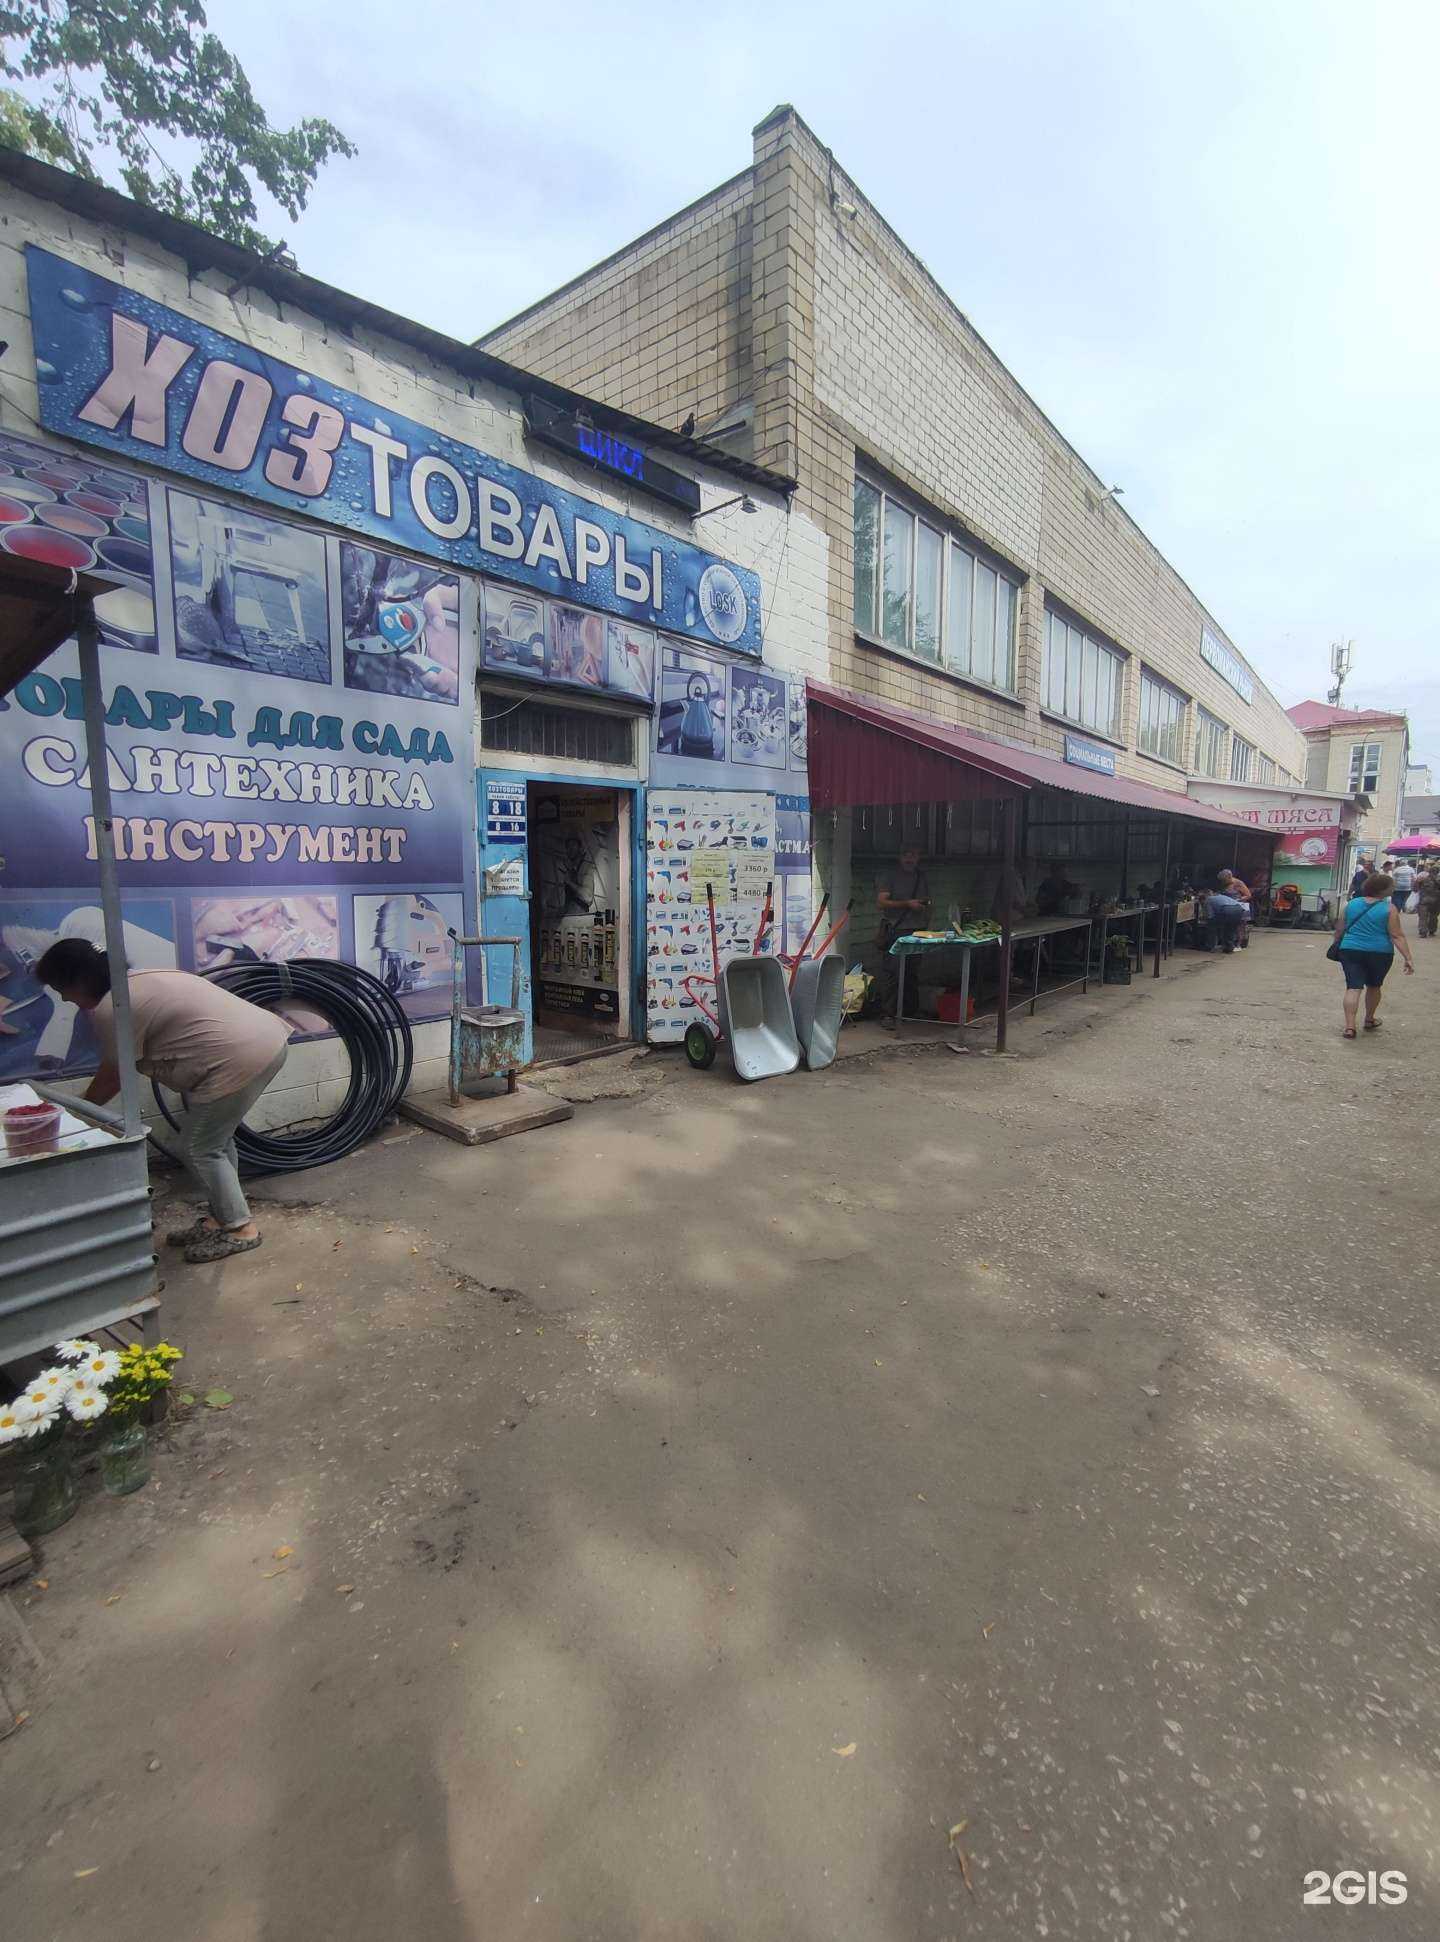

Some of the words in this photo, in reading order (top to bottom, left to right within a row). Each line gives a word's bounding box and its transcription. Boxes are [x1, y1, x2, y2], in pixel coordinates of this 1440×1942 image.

[709, 589, 738, 615] LOSK
[0, 671, 237, 738] ОВАРЫ
[247, 705, 345, 751] ДЛЯ
[352, 720, 454, 765] САДА
[21, 734, 435, 811] САНТЕХНИКА
[492, 800, 500, 815] 8
[509, 801, 522, 816] 18
[511, 822, 520, 831] 16
